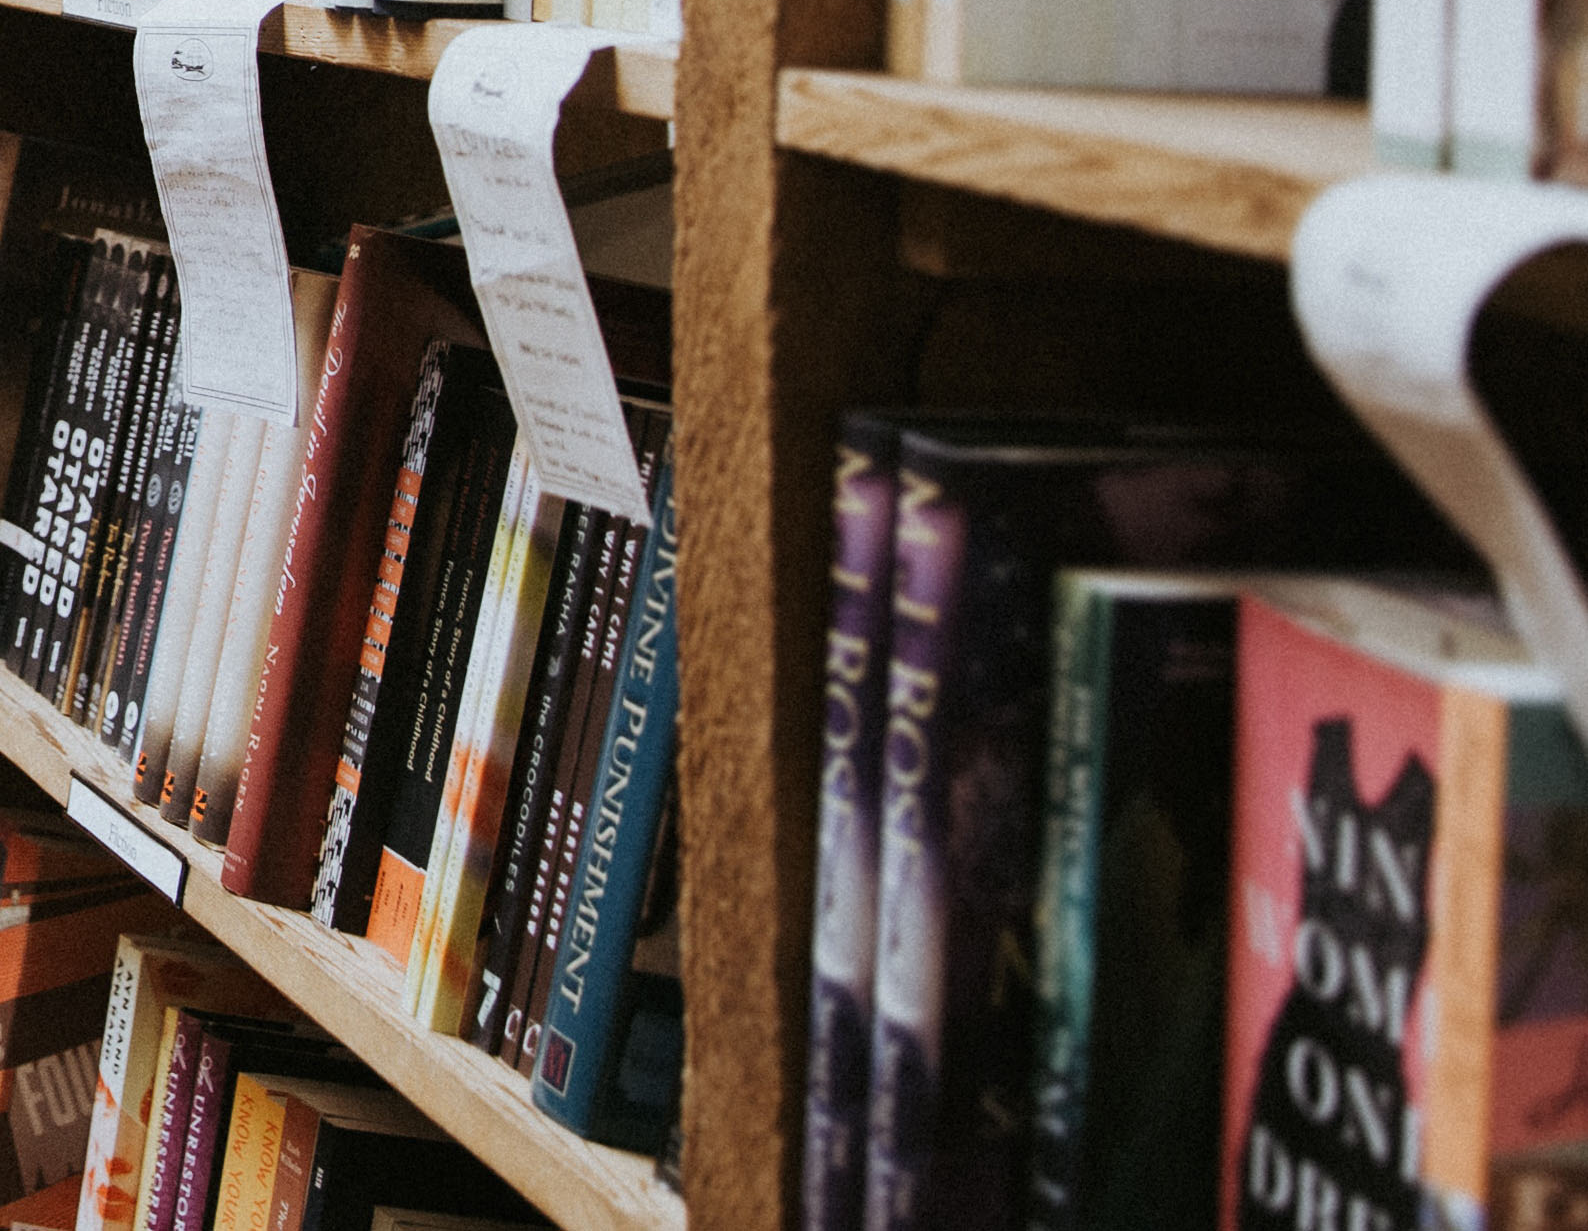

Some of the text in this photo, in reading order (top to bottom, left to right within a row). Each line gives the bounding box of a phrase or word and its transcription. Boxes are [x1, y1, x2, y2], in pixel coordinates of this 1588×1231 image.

[99, 342, 136, 487] IMPERFECTIONISTS
[117, 346, 155, 494] IMPERFECTIONISTS
[131, 353, 168, 502] IMPERFECTIONISTS
[273, 301, 348, 617] The Devil in Jerusalem
[829, 448, 876, 519] M
[23, 420, 72, 596] OTARED
[39, 428, 88, 606] OTARED
[57, 437, 105, 618] OTARED
[894, 469, 944, 548] M
[116, 518, 153, 666] Tom Rachman
[438, 560, 454, 610] France,
[597, 529, 616, 579] WHY
[617, 538, 638, 590] WHY
[136, 526, 174, 676] Tom Rachman
[454, 568, 473, 623] France,
[580, 604, 601, 661] CAME
[427, 617, 444, 658] Story
[447, 626, 464, 669] Story
[600, 613, 622, 672] CAME
[235, 643, 281, 813] NAOMI RAGEN
[407, 693, 429, 772] Childhood
[424, 703, 446, 784] Childhood
[505, 552, 582, 894] RAKHA the CROCODILES
[881, 665, 939, 875] ROSE
[108, 822, 139, 862] Fiction
[543, 788, 565, 852] MARY
[560, 694, 648, 1015] PUNISHMENT
[562, 800, 585, 864] MARY
[1287, 785, 1424, 925] NIN
[527, 858, 550, 938] RAKOW
[545, 871, 570, 952] RAKOW
[103, 958, 124, 1061] AYN RAND
[112, 971, 134, 1076] AYN RAND
[234, 1093, 256, 1159] KNOW
[256, 1120, 280, 1188] KNOW
